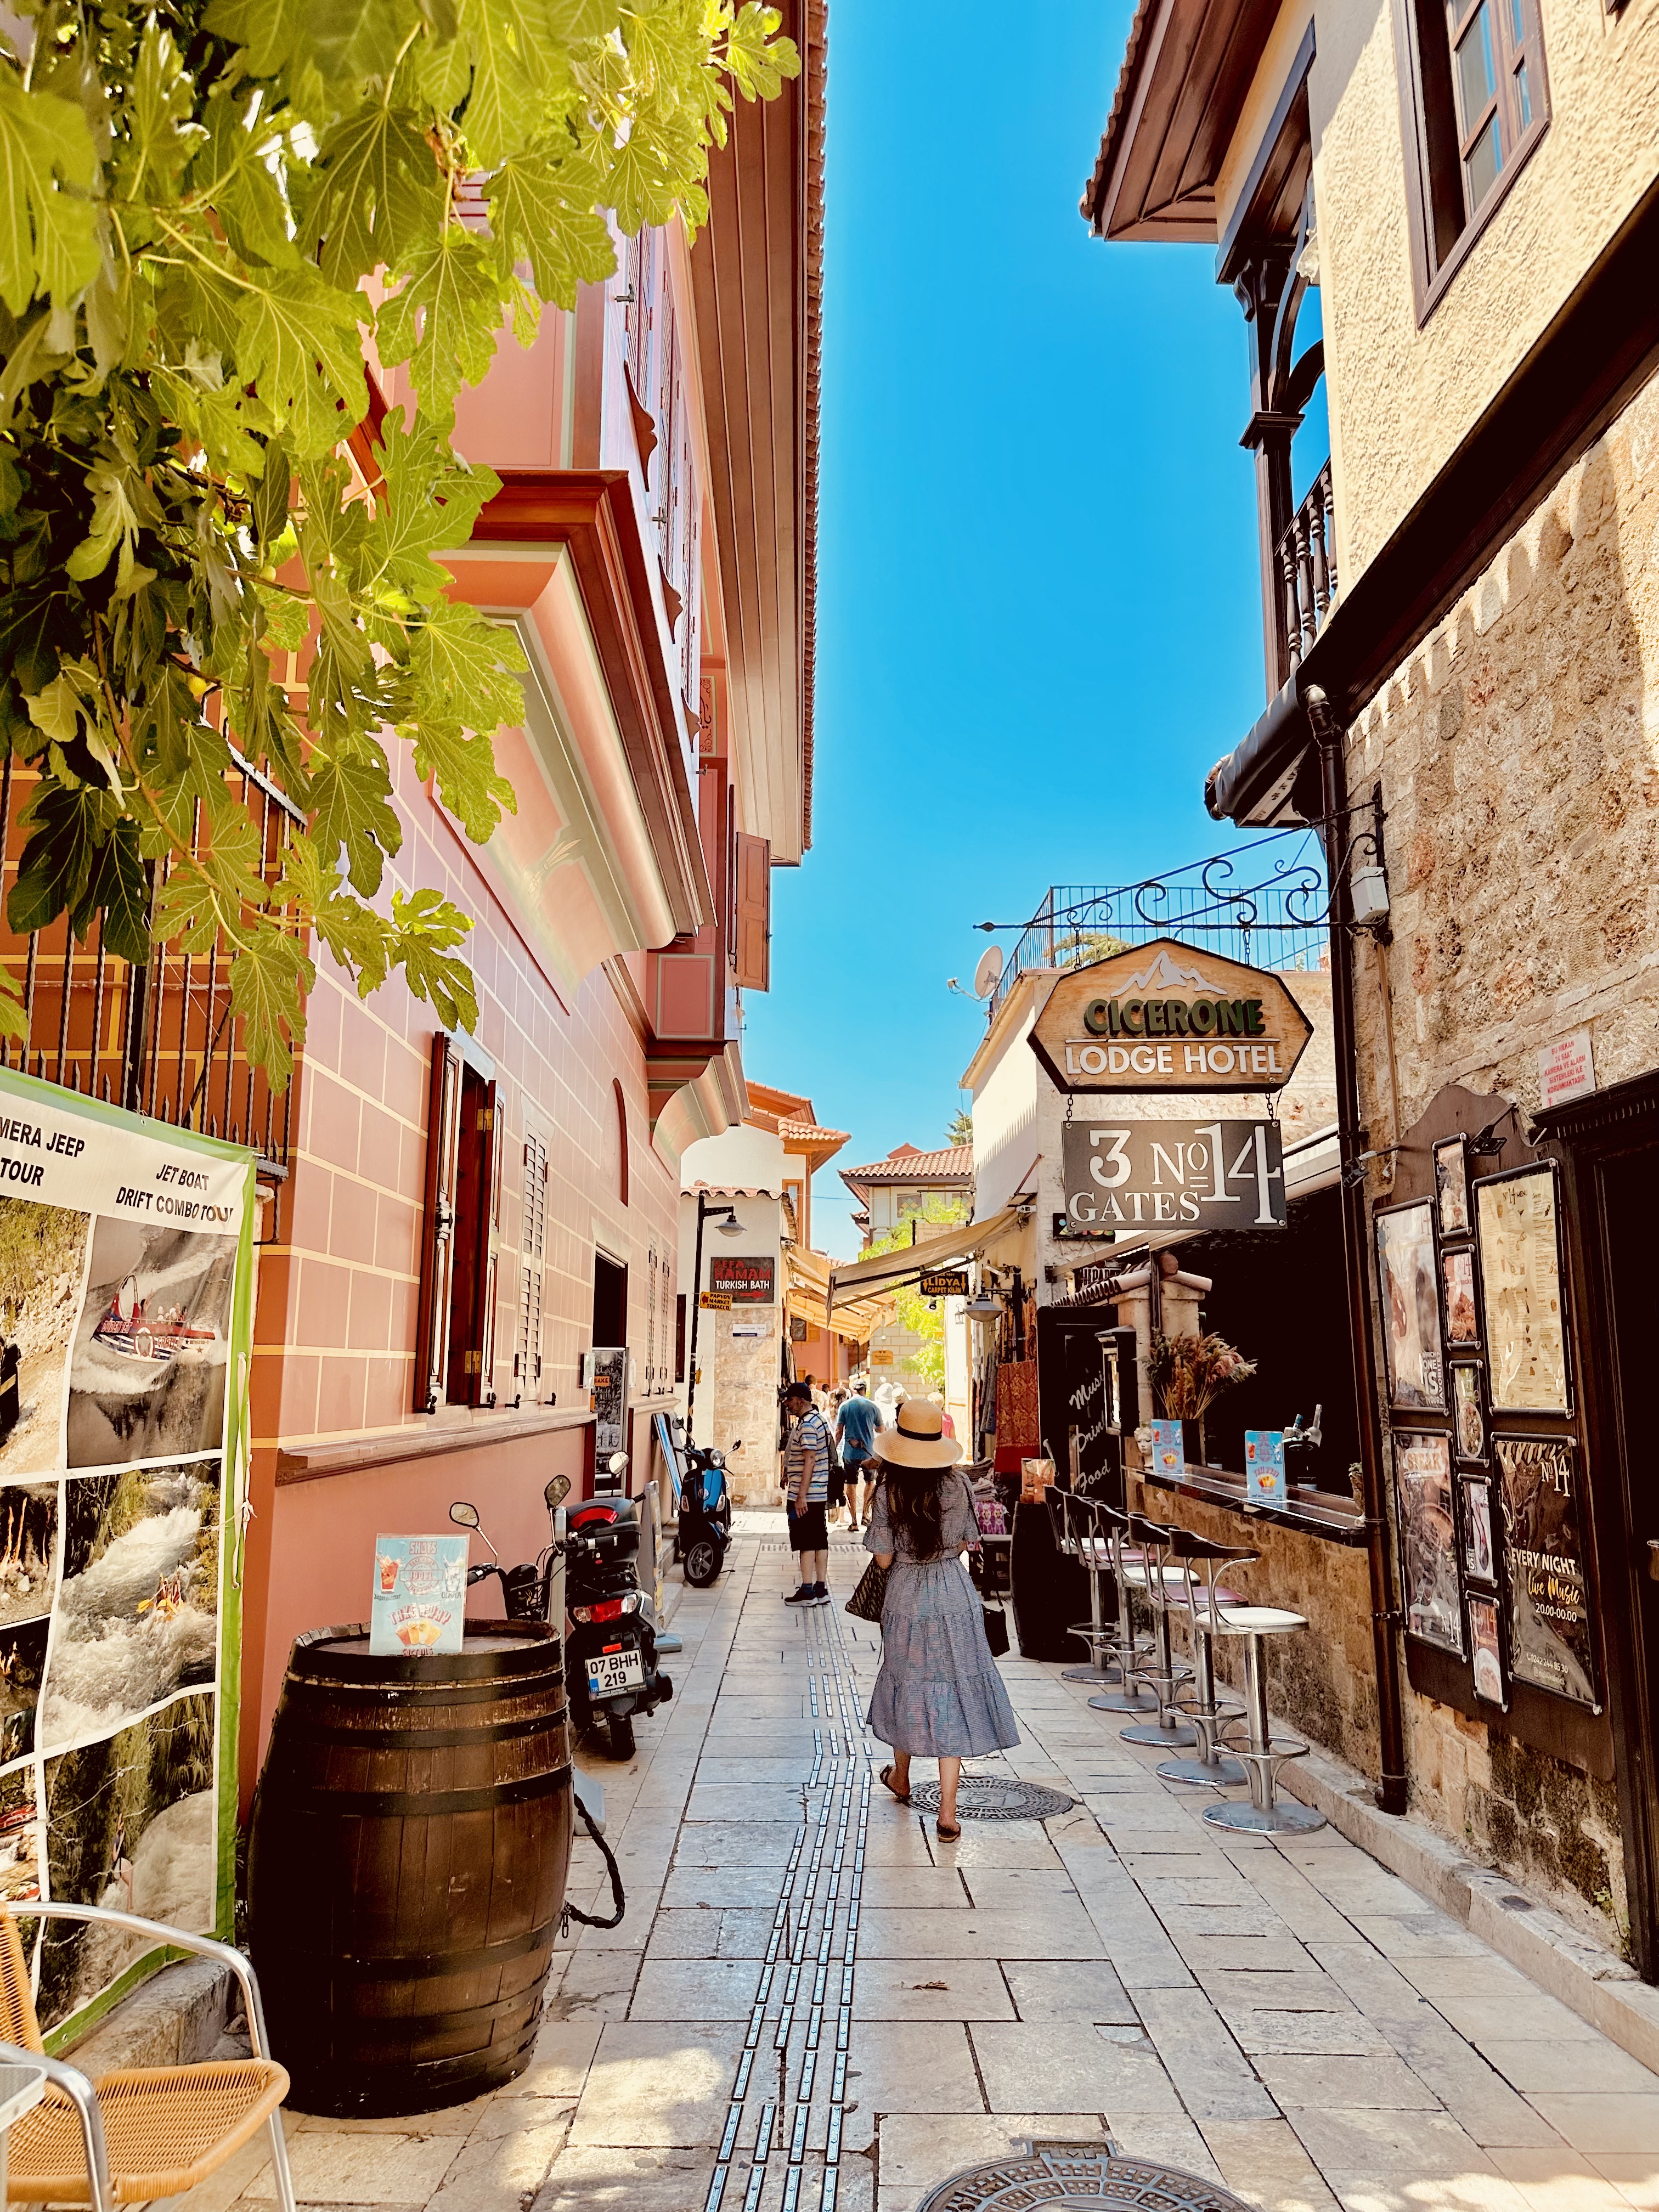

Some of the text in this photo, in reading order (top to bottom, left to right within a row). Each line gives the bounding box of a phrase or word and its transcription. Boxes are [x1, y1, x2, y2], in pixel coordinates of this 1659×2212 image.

[1084, 999, 1265, 1036] CICERONE
[1559, 1040, 1575, 1051] MEKAN
[1561, 1050, 1572, 1060] SAAT
[1065, 1045, 1282, 1074] LODGE HOTEL
[1544, 1064, 1562, 1076] KAMERA
[1571, 1054, 1585, 1065] ALARM
[47, 1132, 84, 1158] JEEP
[0, 1157, 44, 1186] TOUR
[1089, 1130, 1132, 1188] 3
[156, 1164, 210, 1190] JET BOAT
[116, 1187, 153, 1210] DRIFT
[156, 1196, 200, 1218] COMBO
[1069, 1191, 1201, 1222] GATES
[714, 1260, 744, 1268] SEFA
[714, 1268, 771, 1280] HAMAM
[715, 1280, 770, 1289] TURKISH BATH
[1422, 1359, 1437, 1370] ONE
[1069, 1370, 1103, 1409] Musi
[1424, 1371, 1438, 1396] IS
[1075, 1459, 1111, 1494] Food
[1511, 1547, 1576, 1576] EVERY NIGHT
[1548, 1575, 1580, 1604] Music
[1536, 1602, 1577, 1622] 20.00-00.00
[590, 1653, 639, 1674] 07 BHH
[604, 1671, 627, 1688] 219
